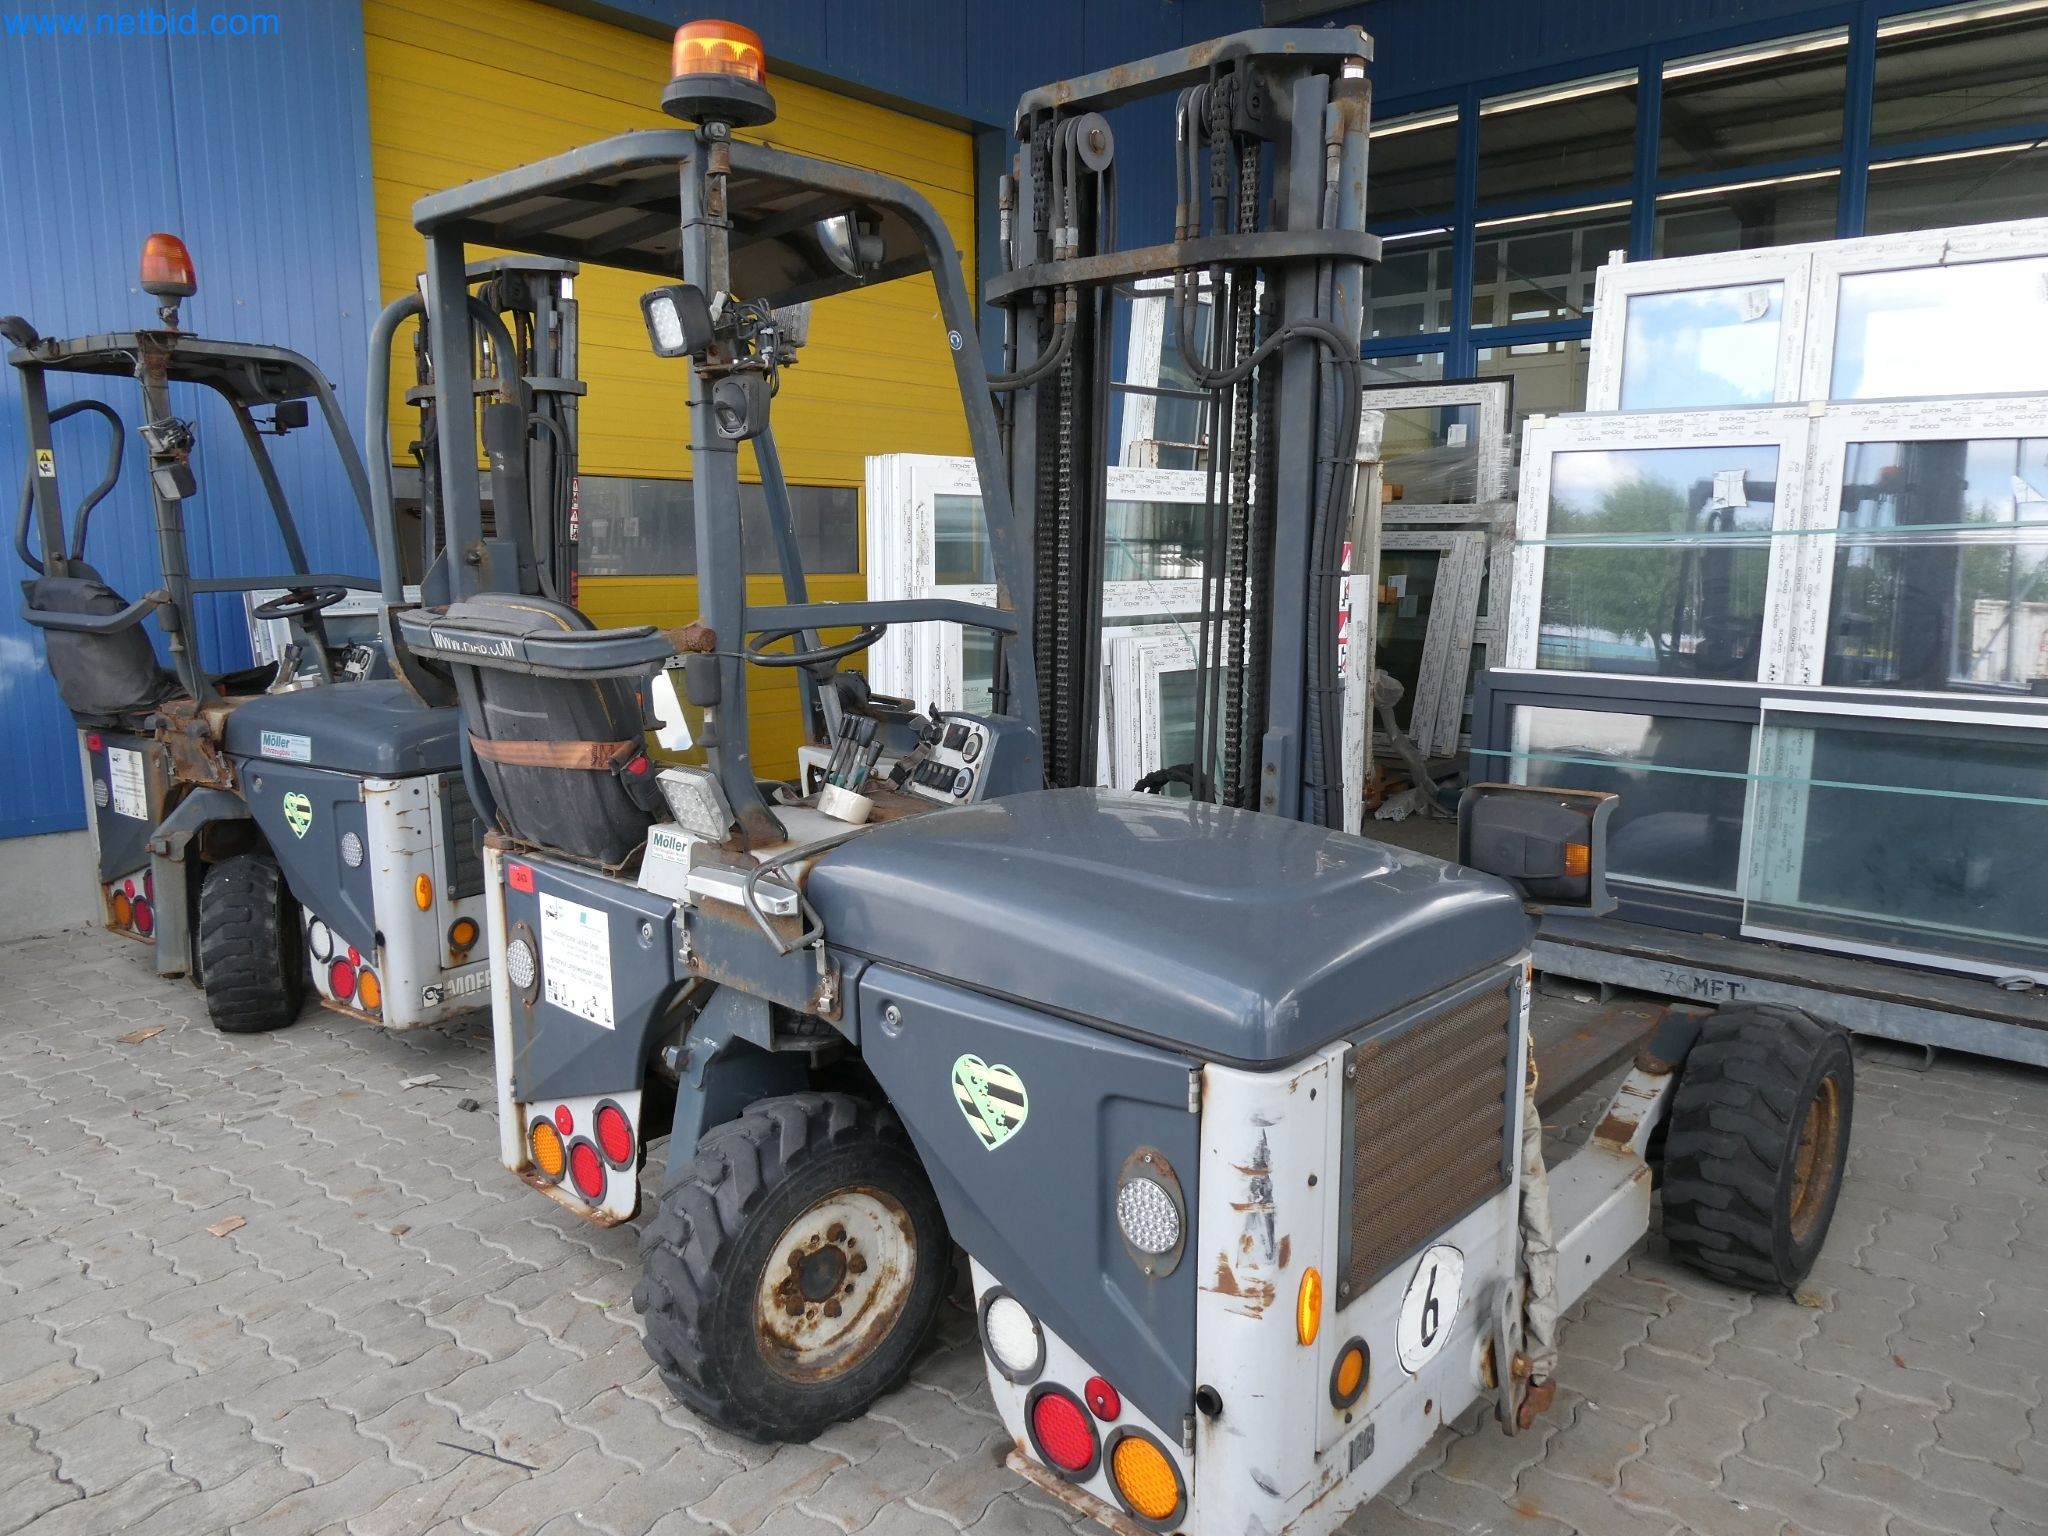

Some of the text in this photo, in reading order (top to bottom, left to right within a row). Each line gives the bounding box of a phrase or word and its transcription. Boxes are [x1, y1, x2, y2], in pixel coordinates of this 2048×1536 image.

[263, 734, 290, 748] Möller
[653, 833, 687, 852] Möller
[1421, 1263, 1438, 1348] 6
